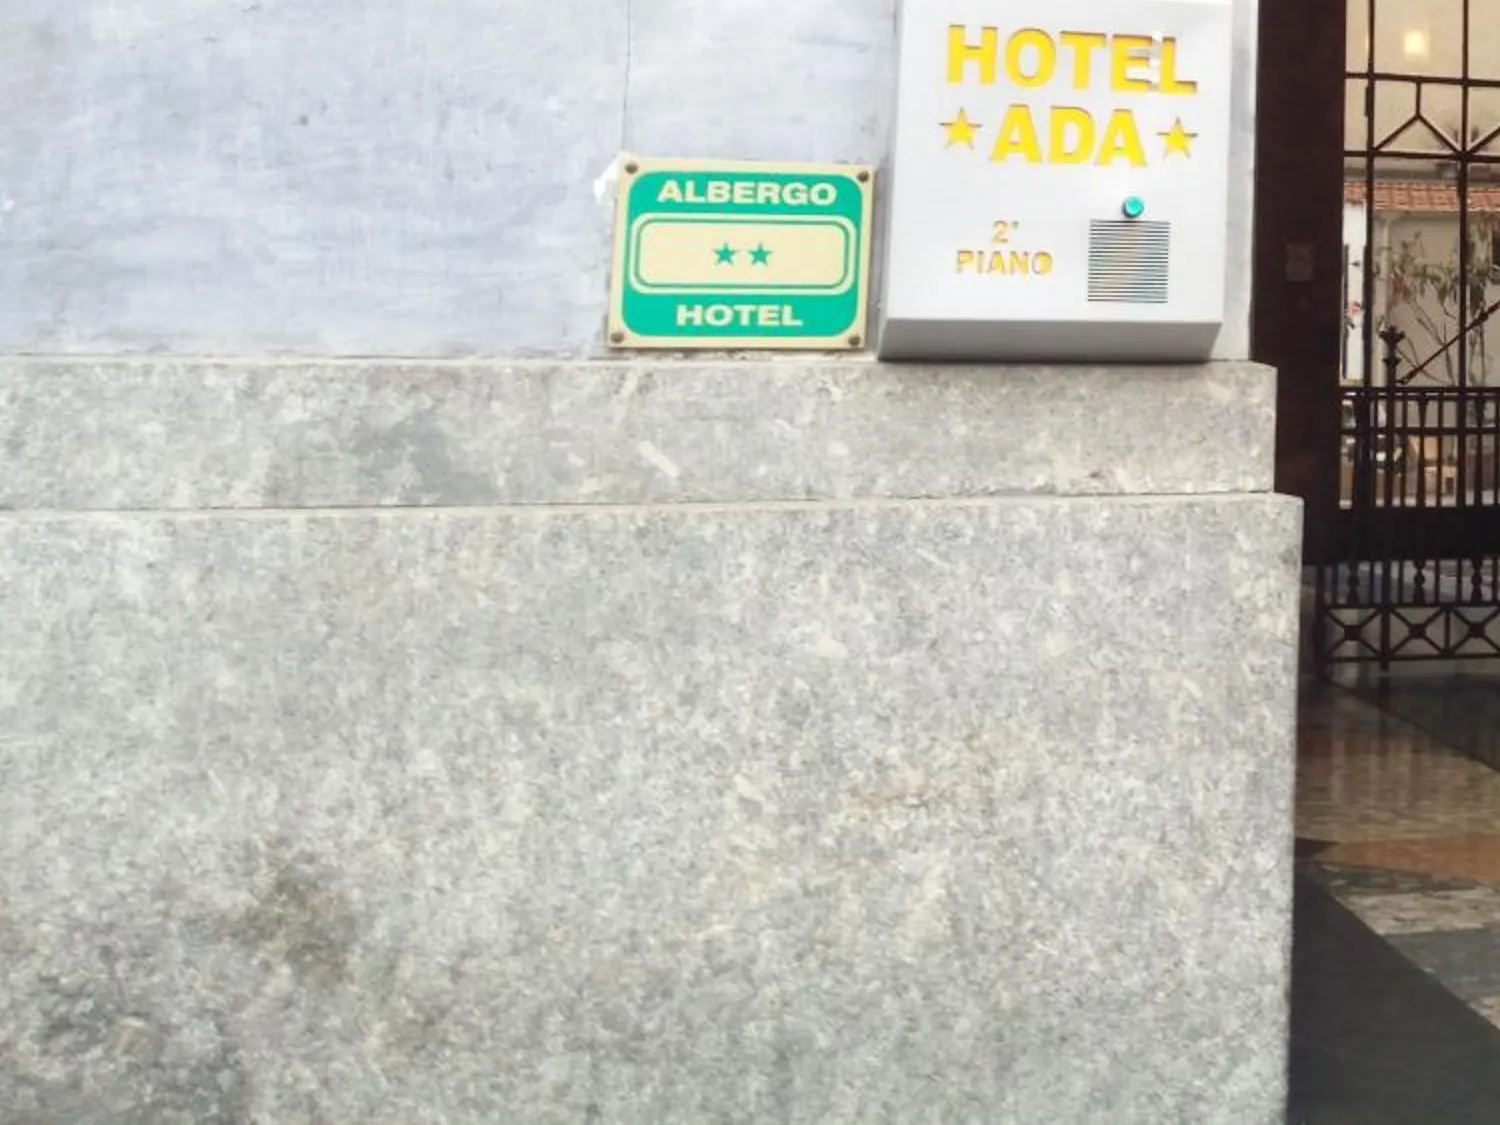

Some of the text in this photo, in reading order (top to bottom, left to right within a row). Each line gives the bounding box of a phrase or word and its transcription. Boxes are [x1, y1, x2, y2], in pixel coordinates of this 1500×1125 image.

[947, 23, 1199, 96] HOTEL
[989, 103, 1149, 168] ADA
[657, 179, 838, 207] ALBERGO
[954, 249, 1053, 276] PIANO
[675, 304, 804, 328] HOTEL
